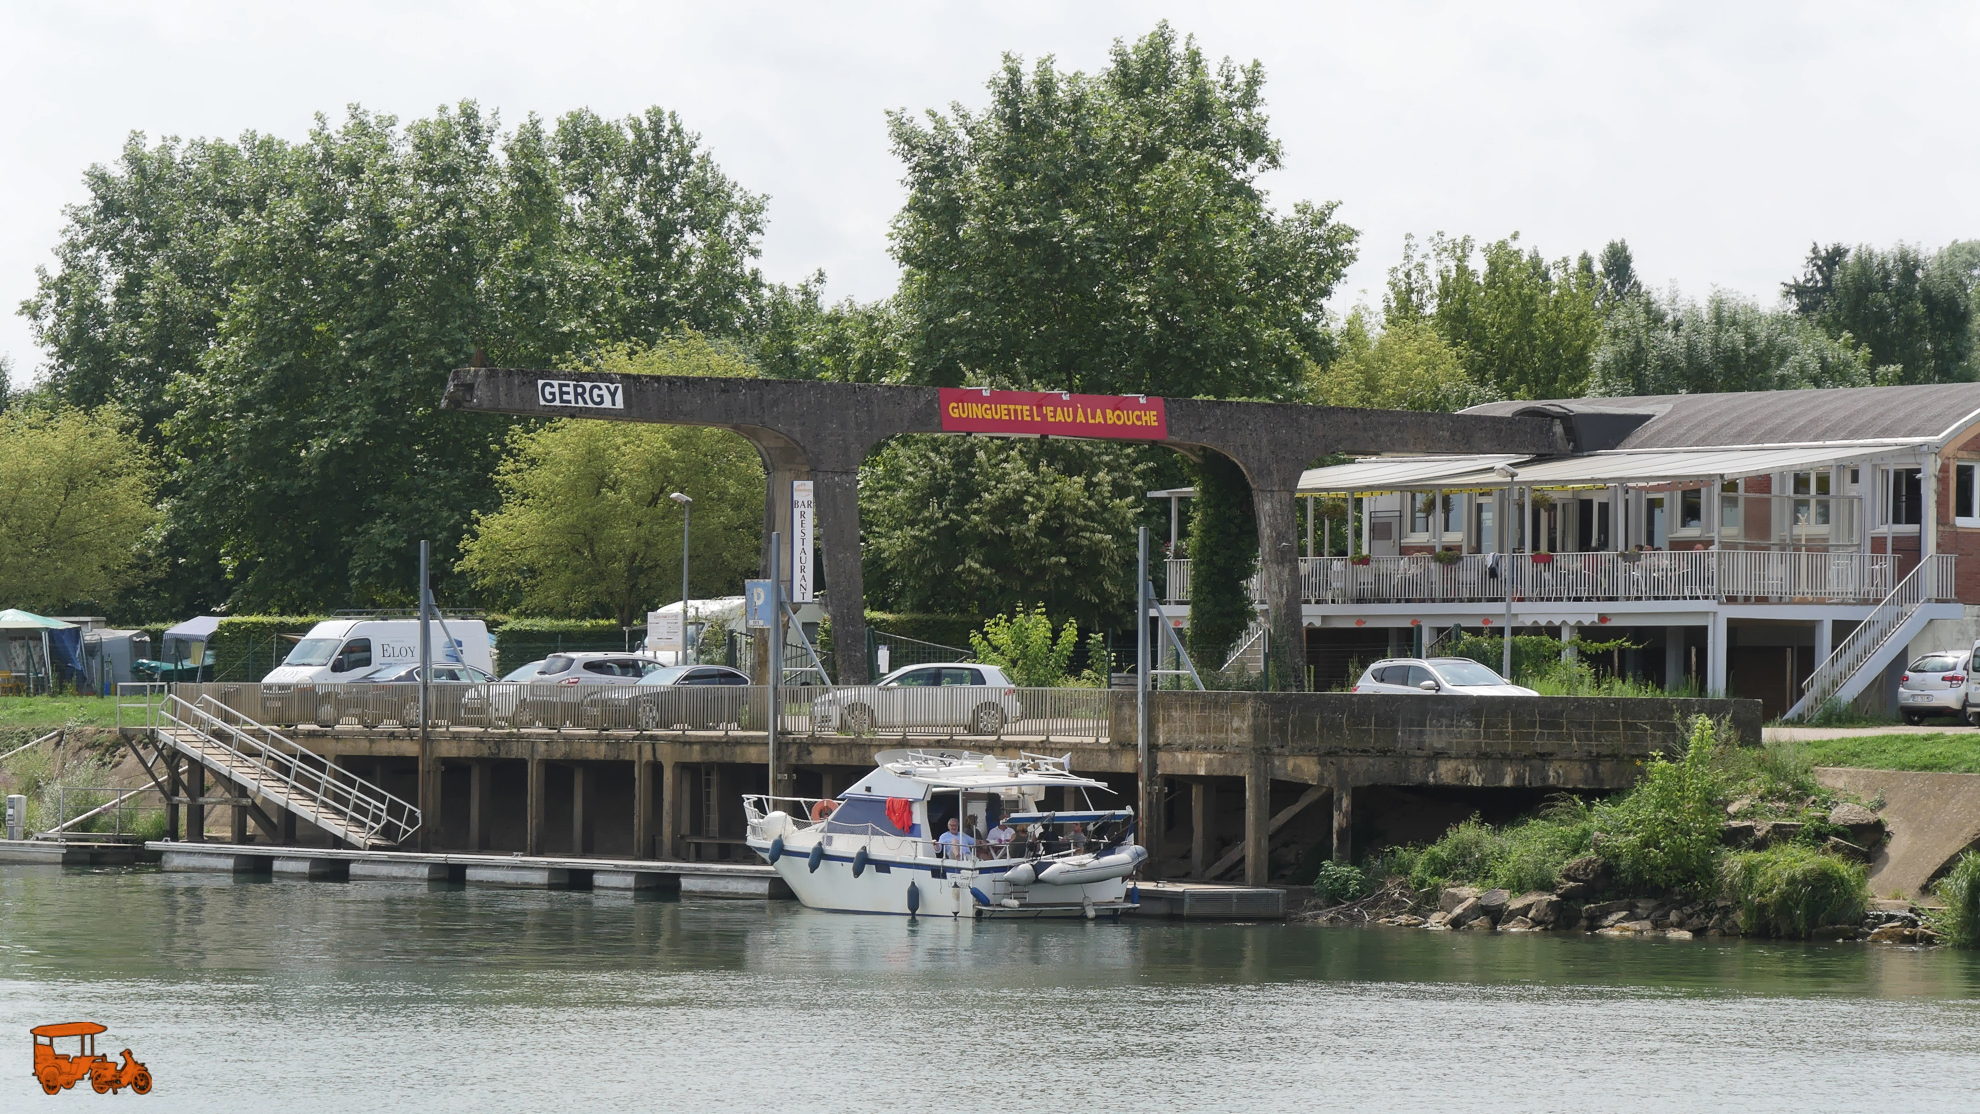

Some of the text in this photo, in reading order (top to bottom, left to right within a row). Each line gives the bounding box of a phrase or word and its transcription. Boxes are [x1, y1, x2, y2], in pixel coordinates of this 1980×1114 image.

[540, 382, 620, 406] GERGY
[948, 402, 1031, 421] GUINGUETTE
[1076, 403, 1086, 423] À
[1087, 408, 1105, 424] LA
[1105, 408, 1159, 426] BOUCHE
[794, 499, 813, 509] BAR
[799, 510, 807, 601] RESTAURANT
[381, 643, 416, 658] ELOY
